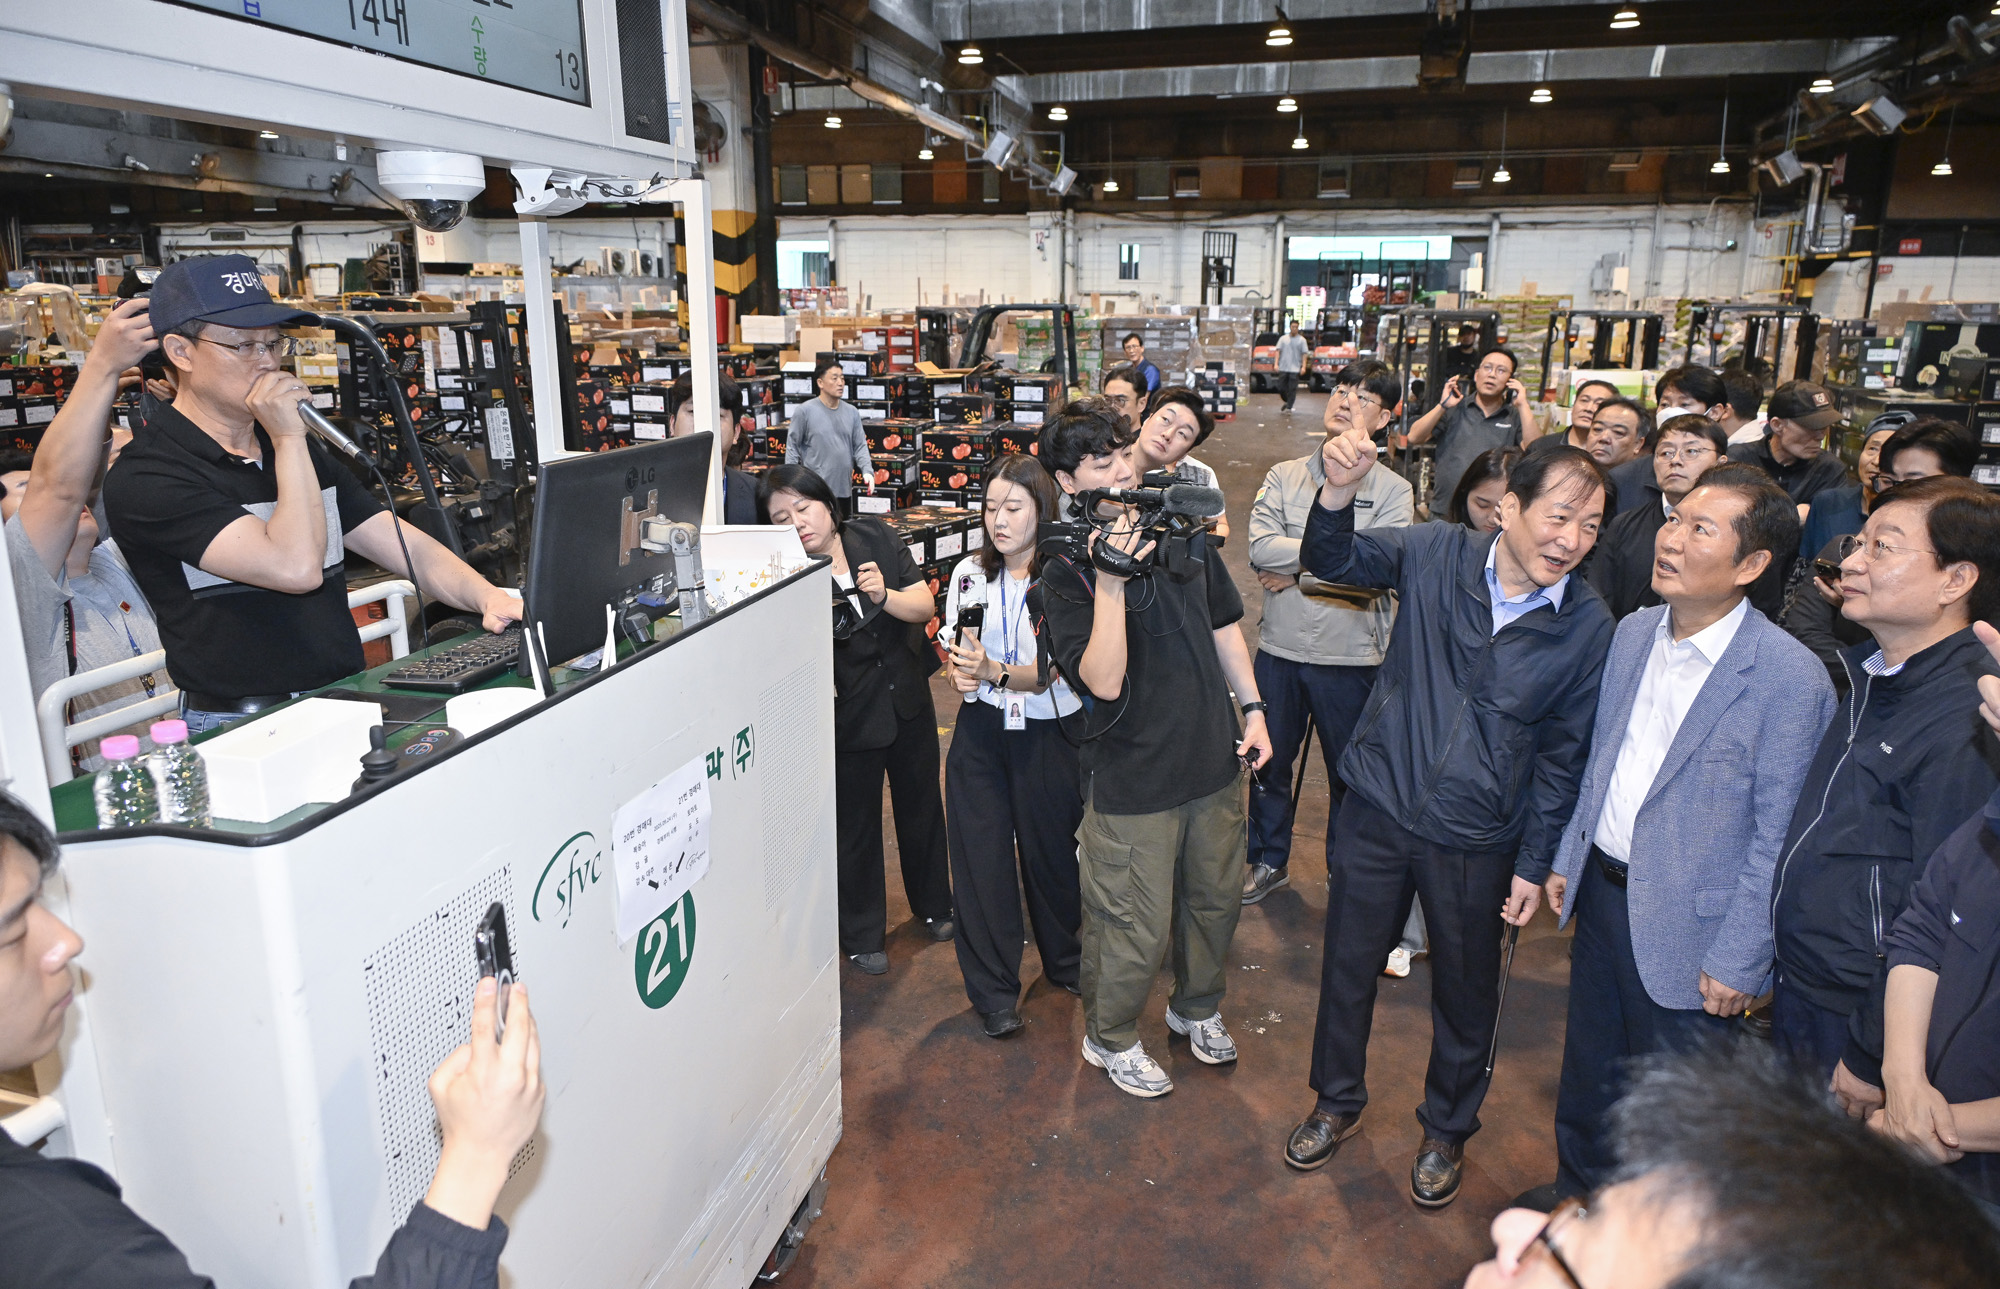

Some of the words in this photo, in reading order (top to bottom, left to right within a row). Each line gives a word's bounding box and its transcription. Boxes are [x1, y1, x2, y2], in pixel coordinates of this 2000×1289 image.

[471, 15, 488, 76] 수량
[555, 48, 580, 91] 13
[425, 235, 435, 246] 13
[641, 467, 656, 485] LG
[1100, 551, 1120, 565] SONY
[731, 723, 755, 780] (주)
[677, 791, 688, 805] 21번
[688, 781, 701, 797] 경매대
[623, 828, 635, 843] 20번
[636, 817, 653, 834] 경매대
[554, 848, 602, 929] sfvc
[644, 897, 688, 996] 21
